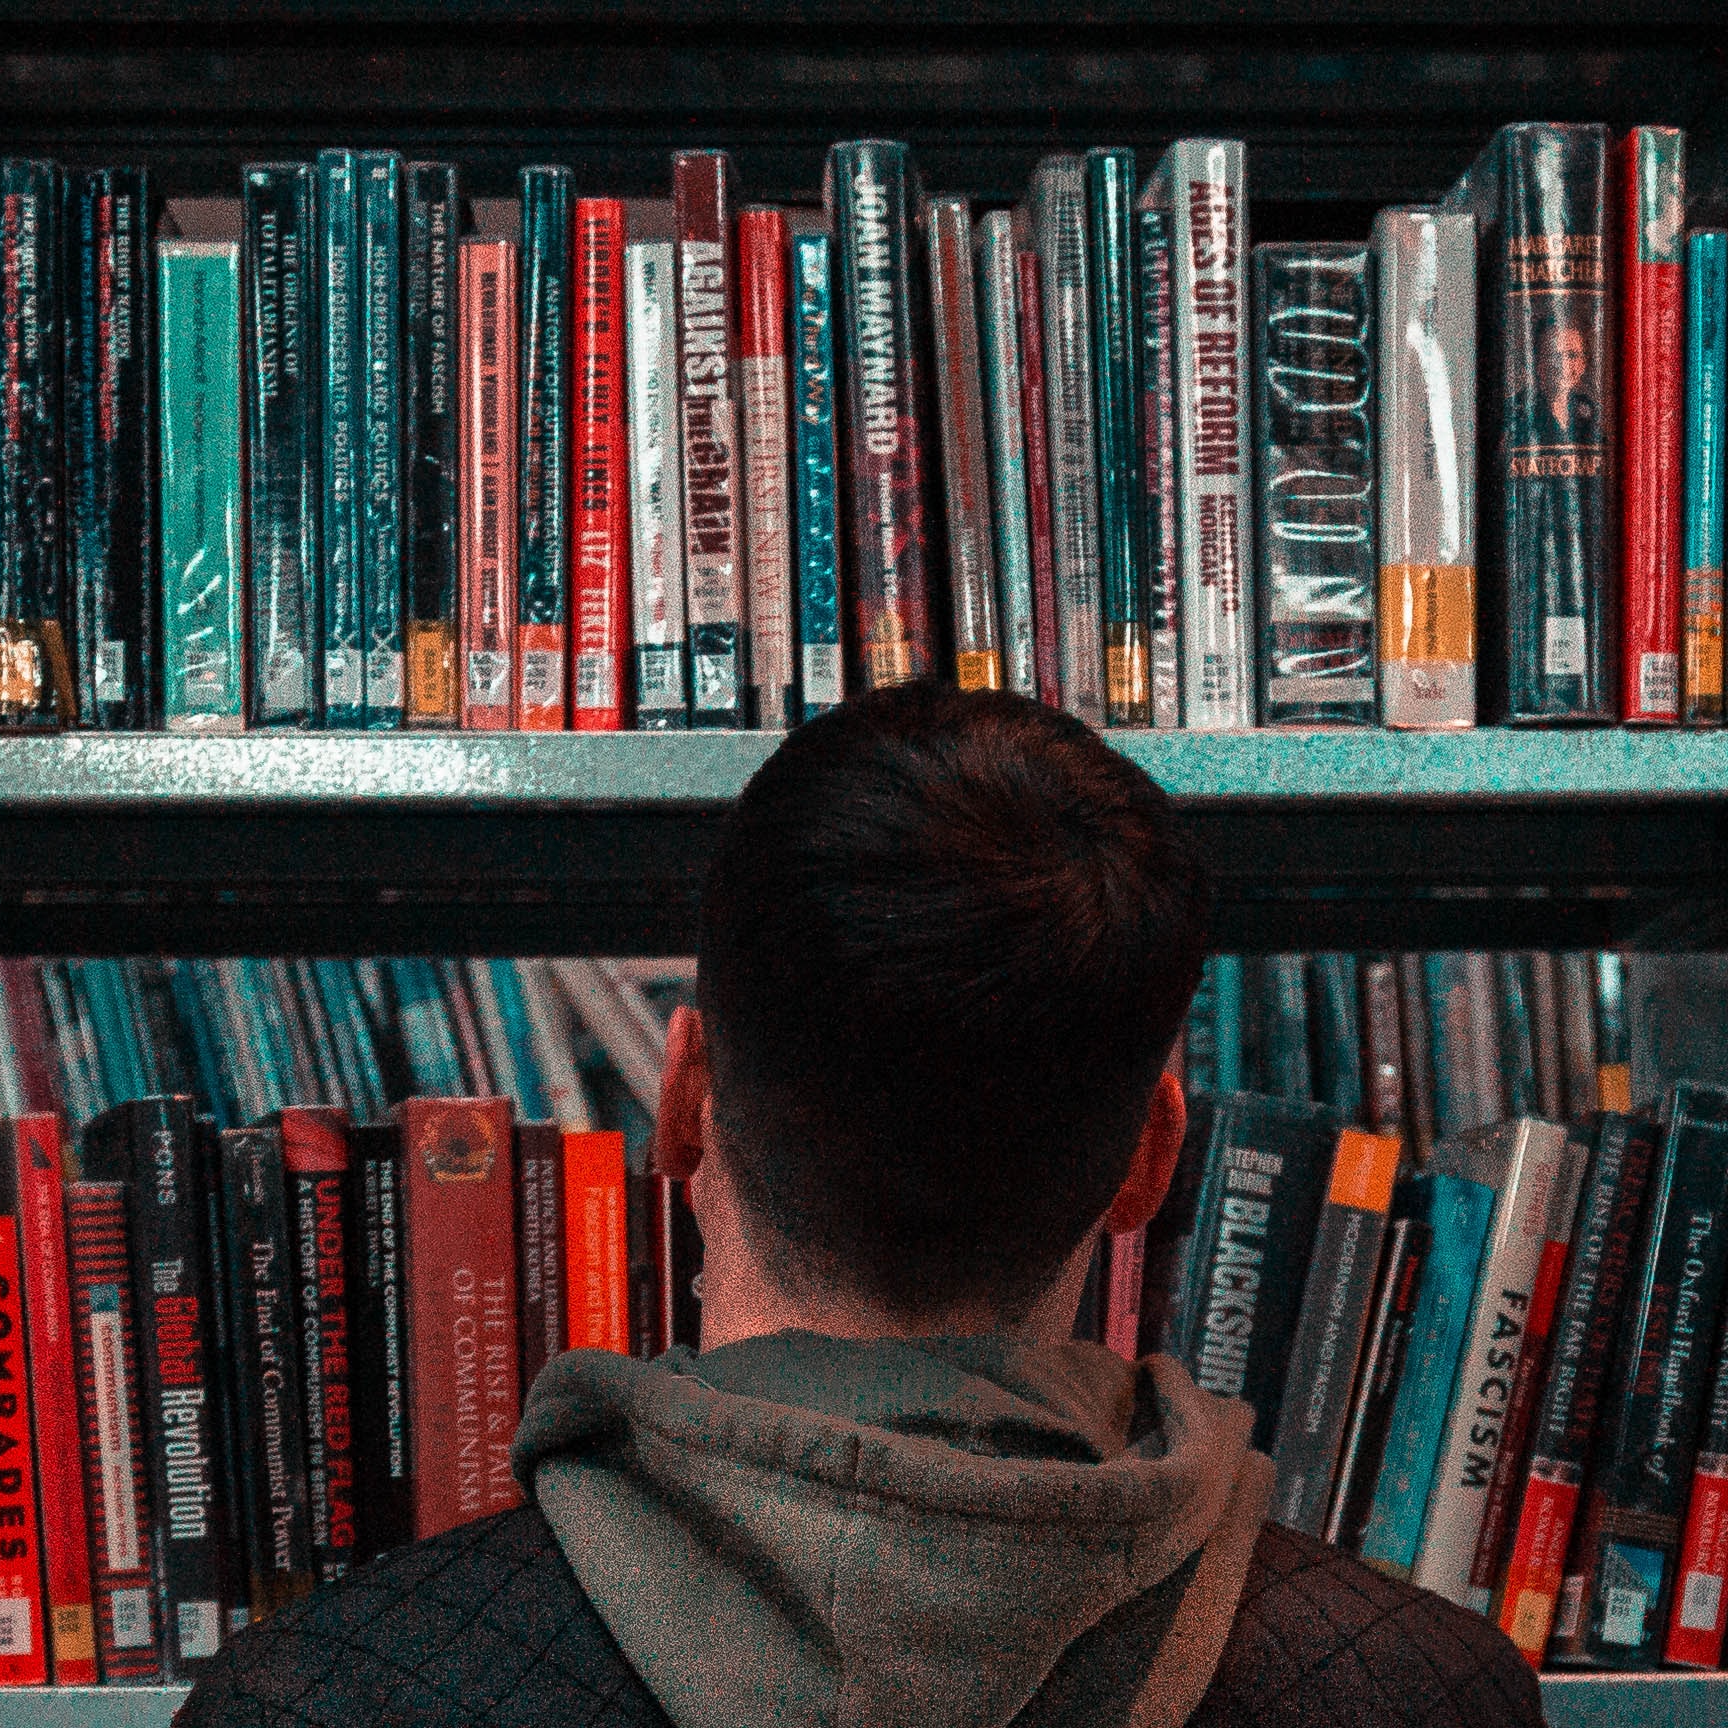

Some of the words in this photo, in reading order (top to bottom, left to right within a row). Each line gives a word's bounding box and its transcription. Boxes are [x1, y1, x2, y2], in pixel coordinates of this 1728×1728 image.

[852, 174, 889, 276] JOAN
[1189, 180, 1235, 269] AGES
[682, 242, 728, 400] AGAINST
[1193, 279, 1236, 322] OF
[859, 280, 897, 454] MAYNARD
[1195, 332, 1239, 476] REFORM
[690, 442, 731, 555] GRAIN
[1199, 495, 1218, 588] MORGAN
[152, 1129, 176, 1204] PONS
[298, 1179, 312, 1194] A
[152, 1259, 183, 1293] The
[253, 1239, 275, 1281] The
[298, 1199, 316, 1279] HISTORY
[318, 1179, 342, 1297] UNDER
[254, 1290, 278, 1334] End
[303, 1286, 316, 1310] OF
[453, 1269, 478, 1310] OF
[481, 1278, 506, 1333] THE
[153, 1296, 201, 1384] Global
[256, 1340, 280, 1364] of
[303, 1318, 321, 1438] COMMUNISM
[323, 1310, 345, 1377] THE
[484, 1344, 507, 1403] RISE
[101, 1324, 125, 1452] communism
[326, 1384, 349, 1450] RED
[454, 1315, 480, 1512] COMMUNISM
[488, 1412, 508, 1434] &
[1461, 1290, 1528, 1491] FASCISM
[159, 1390, 209, 1539] Revolution
[258, 1370, 285, 1498] Communist
[309, 1444, 322, 1461] IN
[311, 1469, 327, 1545] BRITAIN
[328, 1458, 356, 1548] FLAG
[488, 1444, 511, 1501] FALL
[272, 1505, 292, 1571] Power
